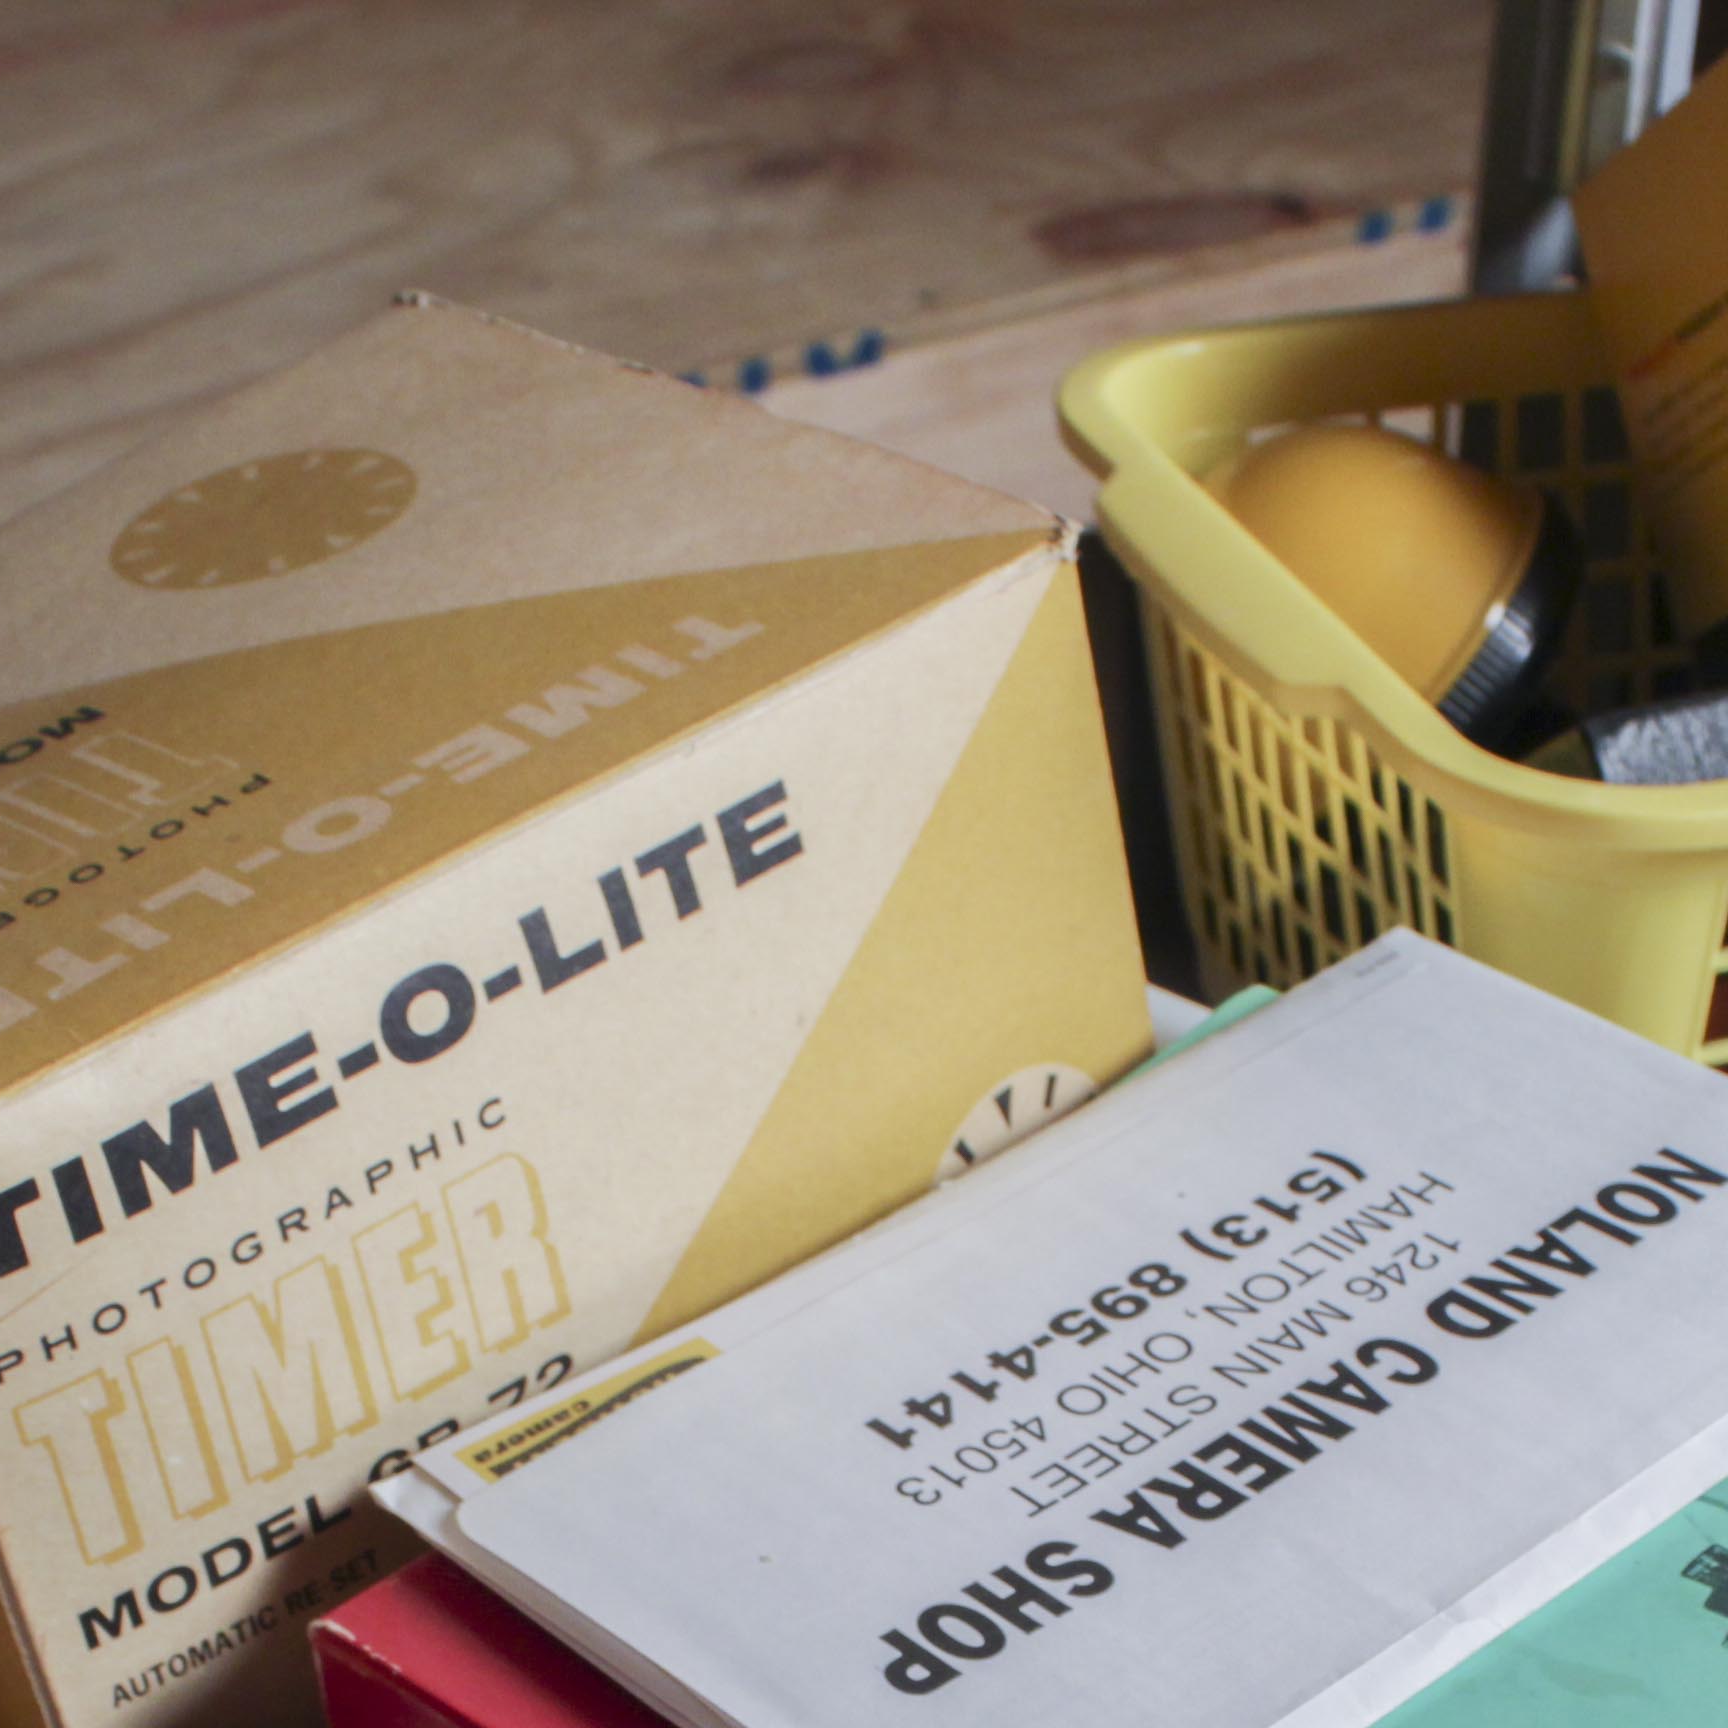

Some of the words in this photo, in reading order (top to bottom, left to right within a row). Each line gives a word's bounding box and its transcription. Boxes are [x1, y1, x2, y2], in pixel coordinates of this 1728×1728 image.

[1178, 1149, 1368, 1264] (513)
[1185, 1170, 1455, 1331] HAMILTON,
[1366, 1233, 1461, 1305] 1246
[12, 1150, 572, 1569] TIMER
[864, 1262, 1188, 1453] 895-4141
[1056, 1330, 1194, 1418] OHIO
[1213, 1300, 1355, 1390] MAIN
[895, 1410, 1047, 1507] 45013
[1008, 1383, 1218, 1520] STREET
[1089, 1336, 1441, 1552] CAMERA
[78, 1493, 352, 1653] MODEL
[878, 1539, 1115, 1696] SHOP
[112, 1605, 281, 1709] AUTOMATIC
